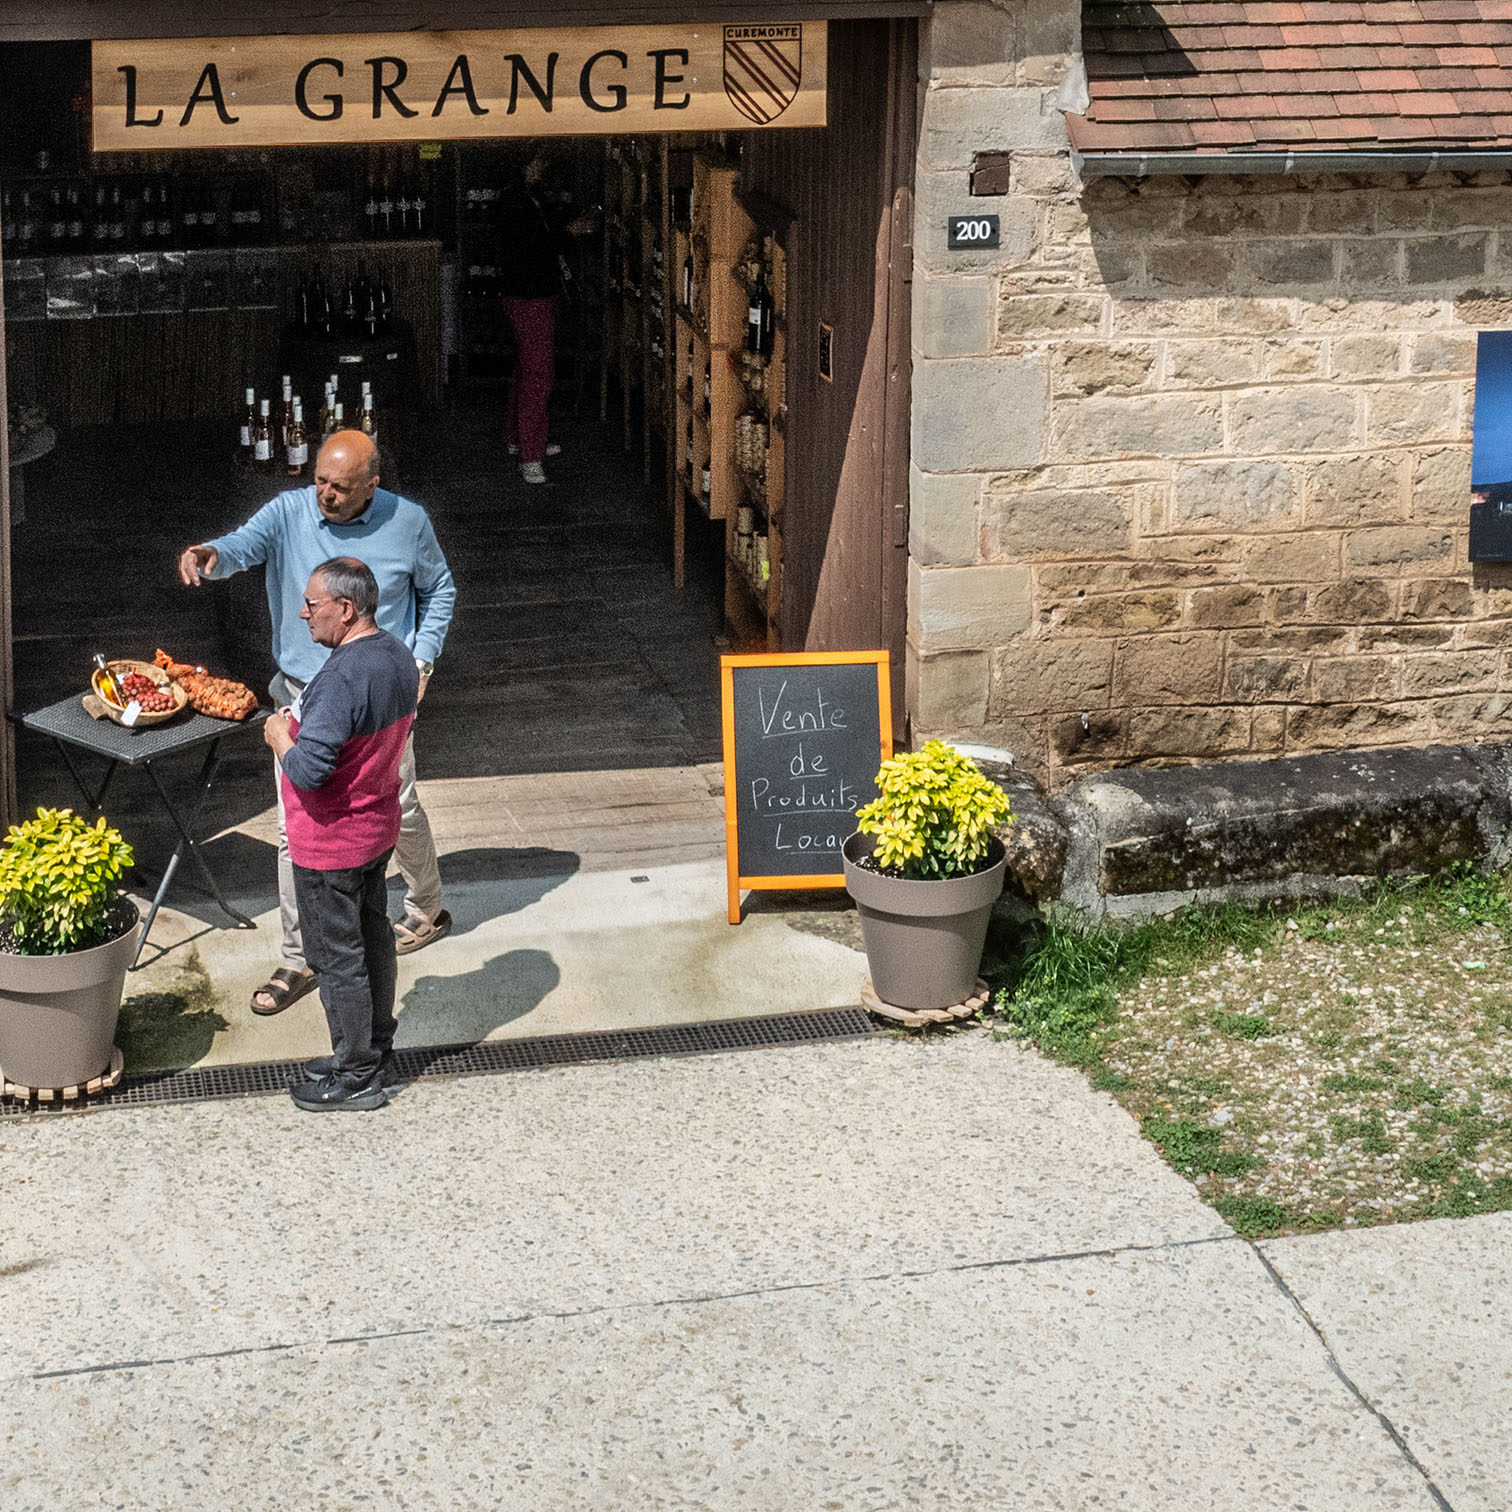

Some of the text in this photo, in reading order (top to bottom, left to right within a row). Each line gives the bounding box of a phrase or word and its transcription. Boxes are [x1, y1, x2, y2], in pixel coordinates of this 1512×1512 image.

[727, 28, 798, 38] CUREMONTE
[117, 48, 690, 128] LA GRANGE
[956, 220, 991, 240] 200
[758, 680, 848, 735] Vente
[790, 742, 828, 776] de
[752, 776, 859, 811] Produits
